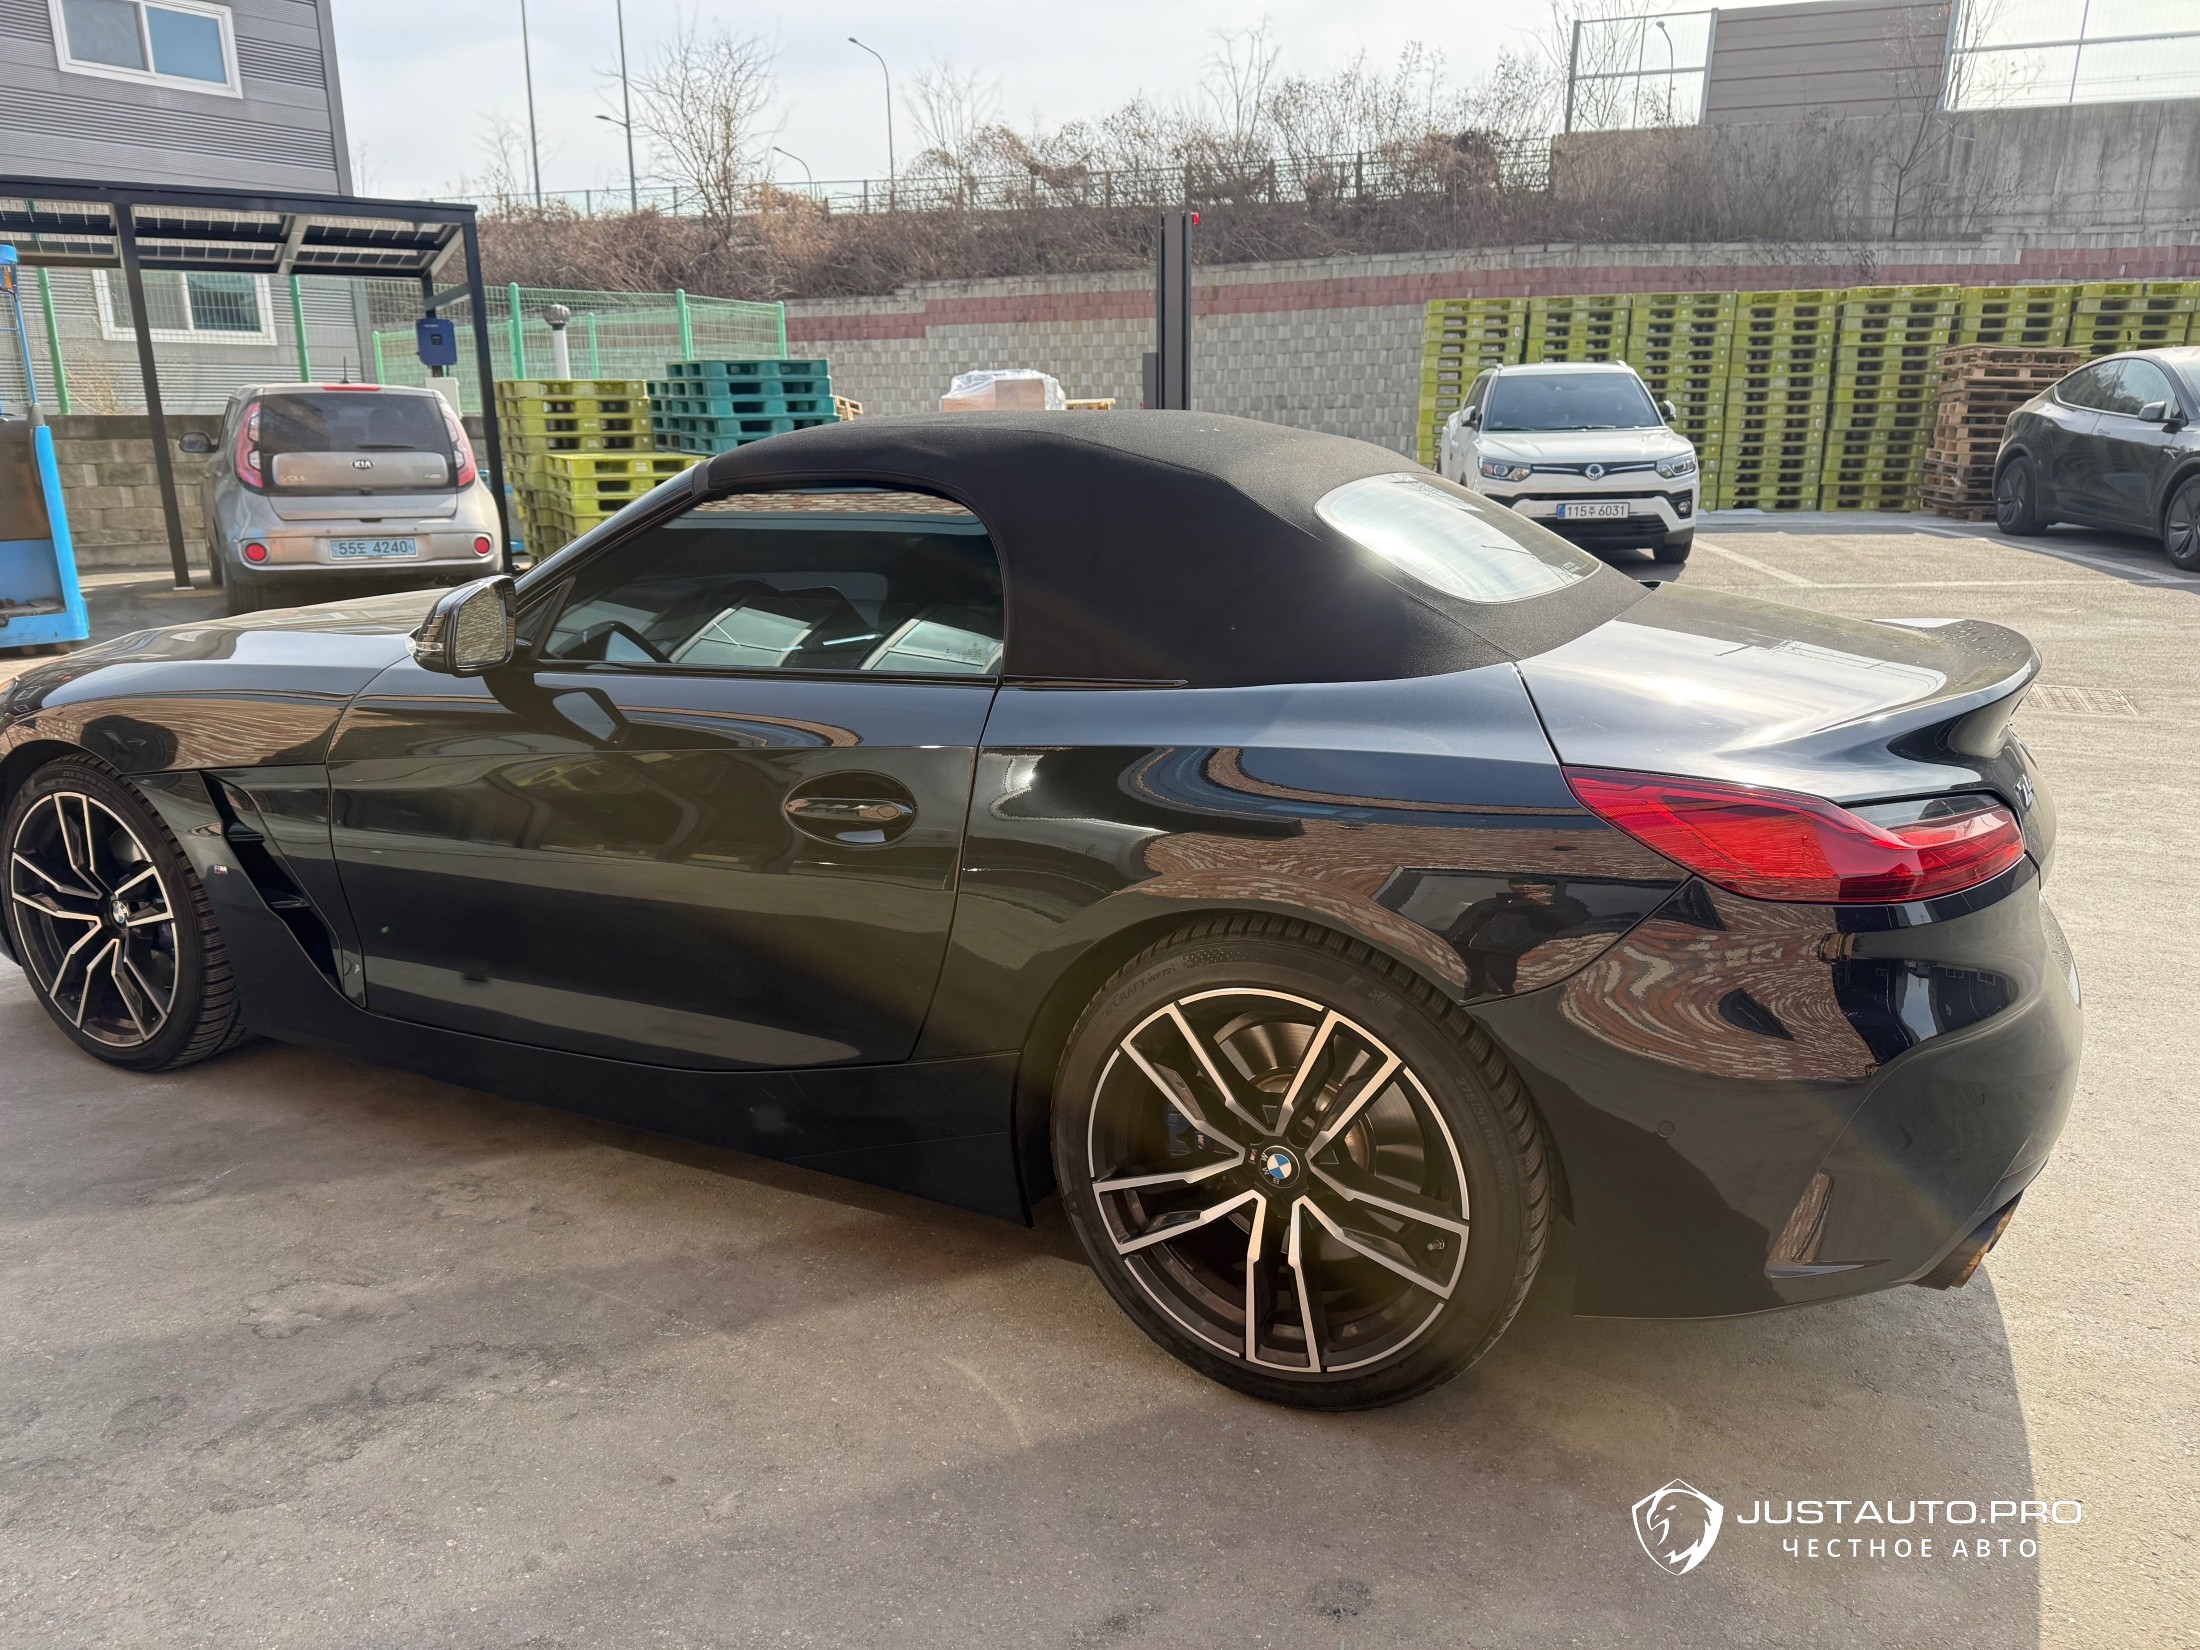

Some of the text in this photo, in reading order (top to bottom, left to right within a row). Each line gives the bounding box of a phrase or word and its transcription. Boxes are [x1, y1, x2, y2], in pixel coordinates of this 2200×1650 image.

[355, 460, 373, 468] KIA
[1598, 505, 1625, 516] 6031
[339, 540, 408, 555] 55도 4240
